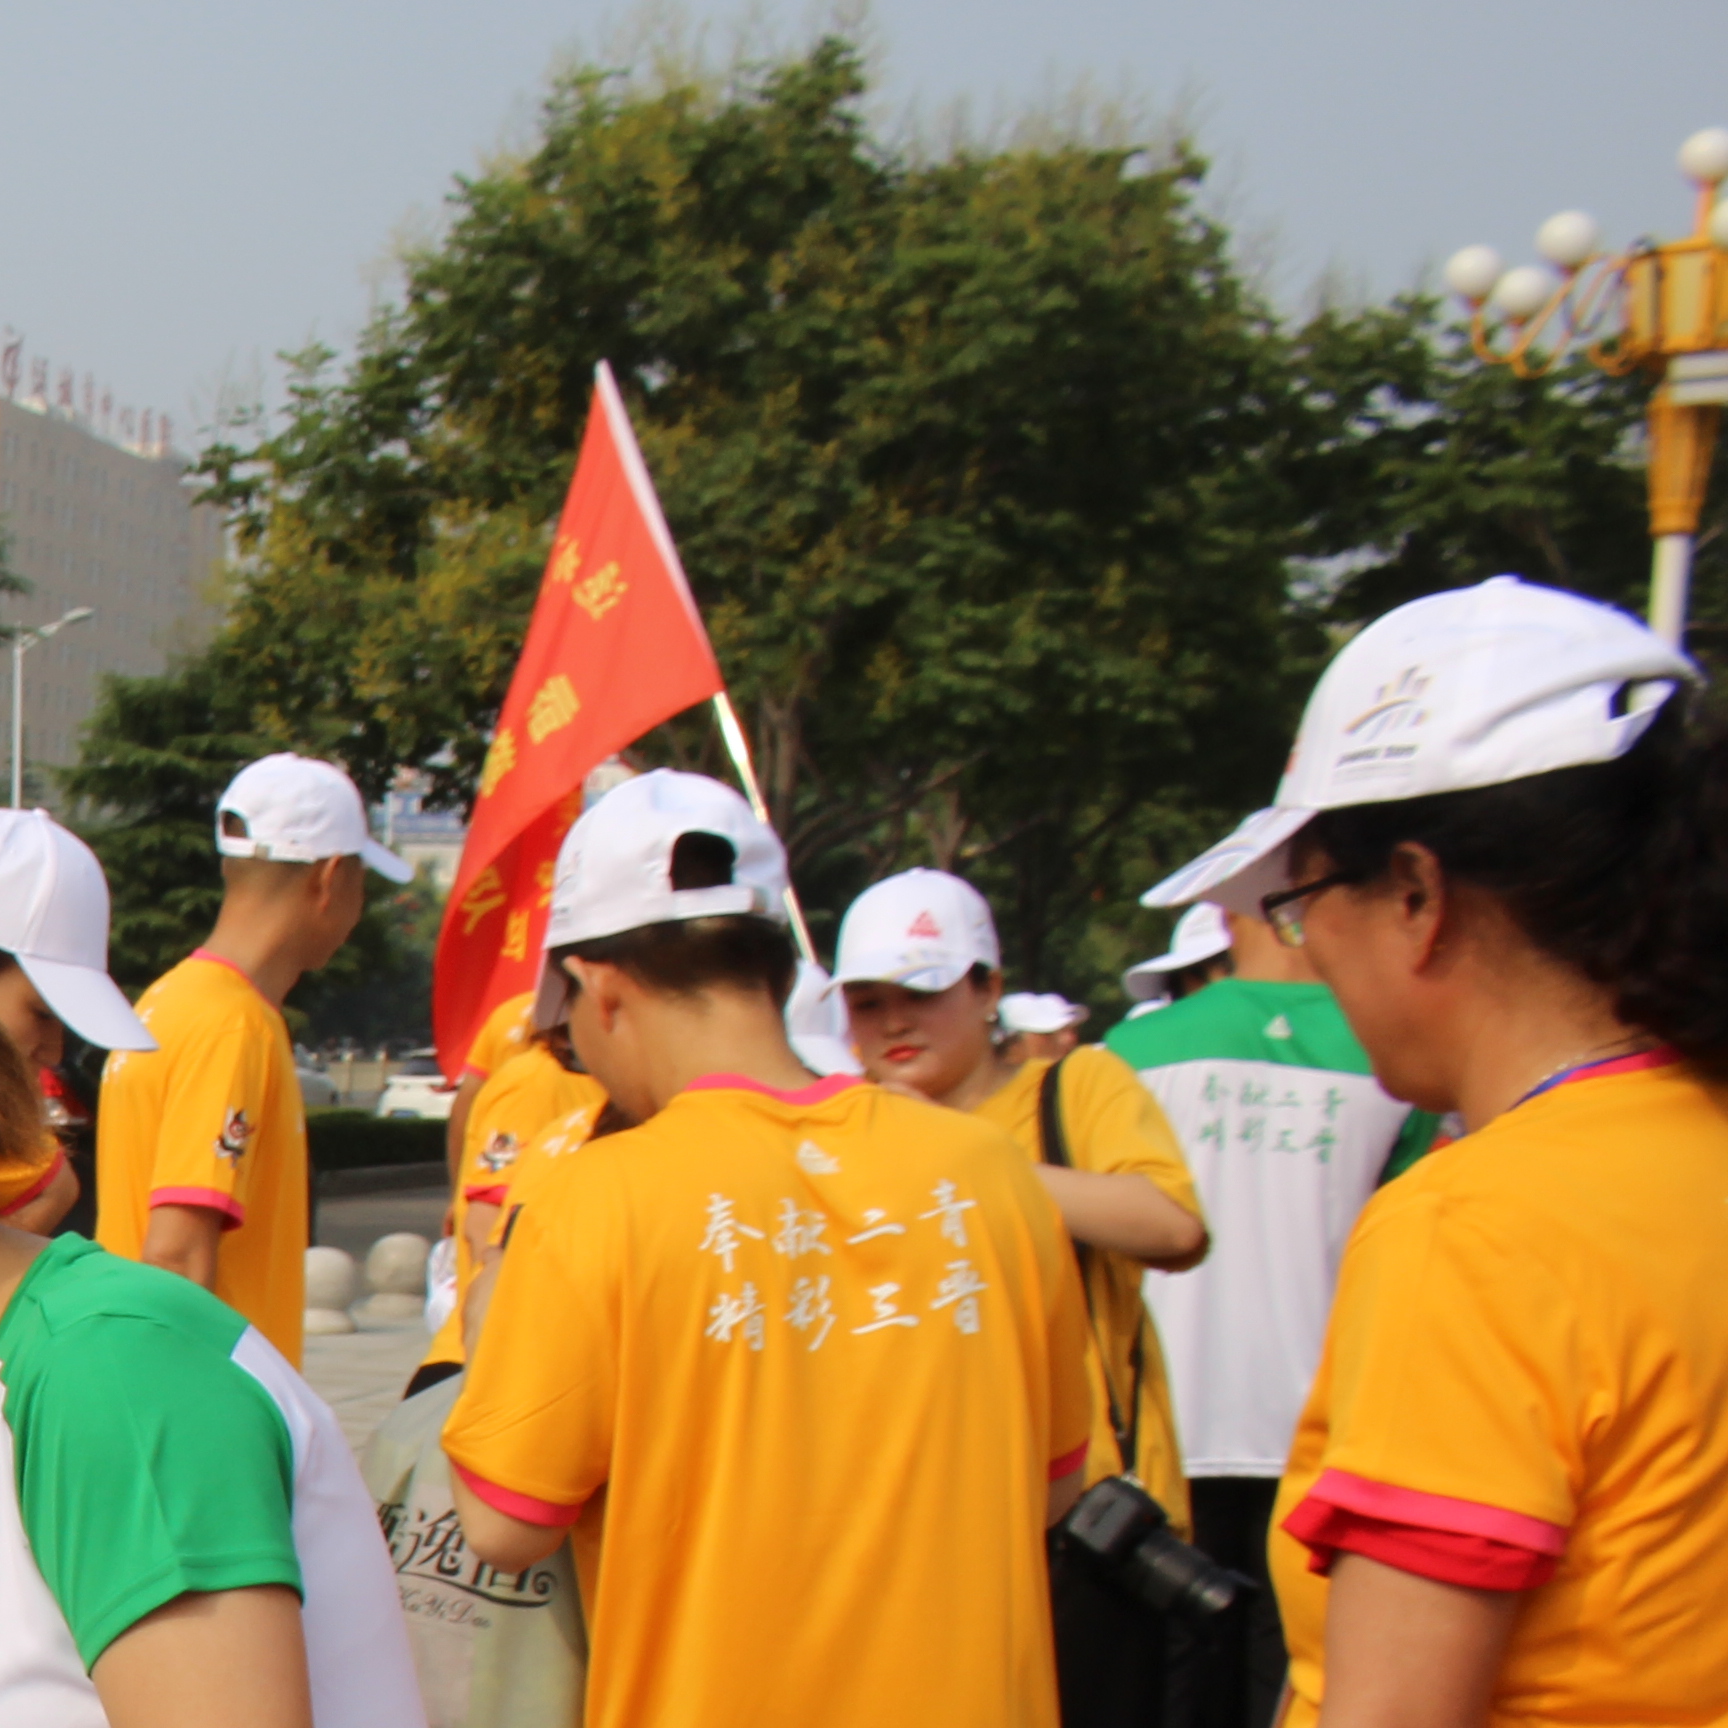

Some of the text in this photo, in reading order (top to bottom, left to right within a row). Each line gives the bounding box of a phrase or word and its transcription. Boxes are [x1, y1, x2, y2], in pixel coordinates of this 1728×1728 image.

[699, 1179, 977, 1273] 奉献二青
[703, 1261, 990, 1353] 精彩三晋
